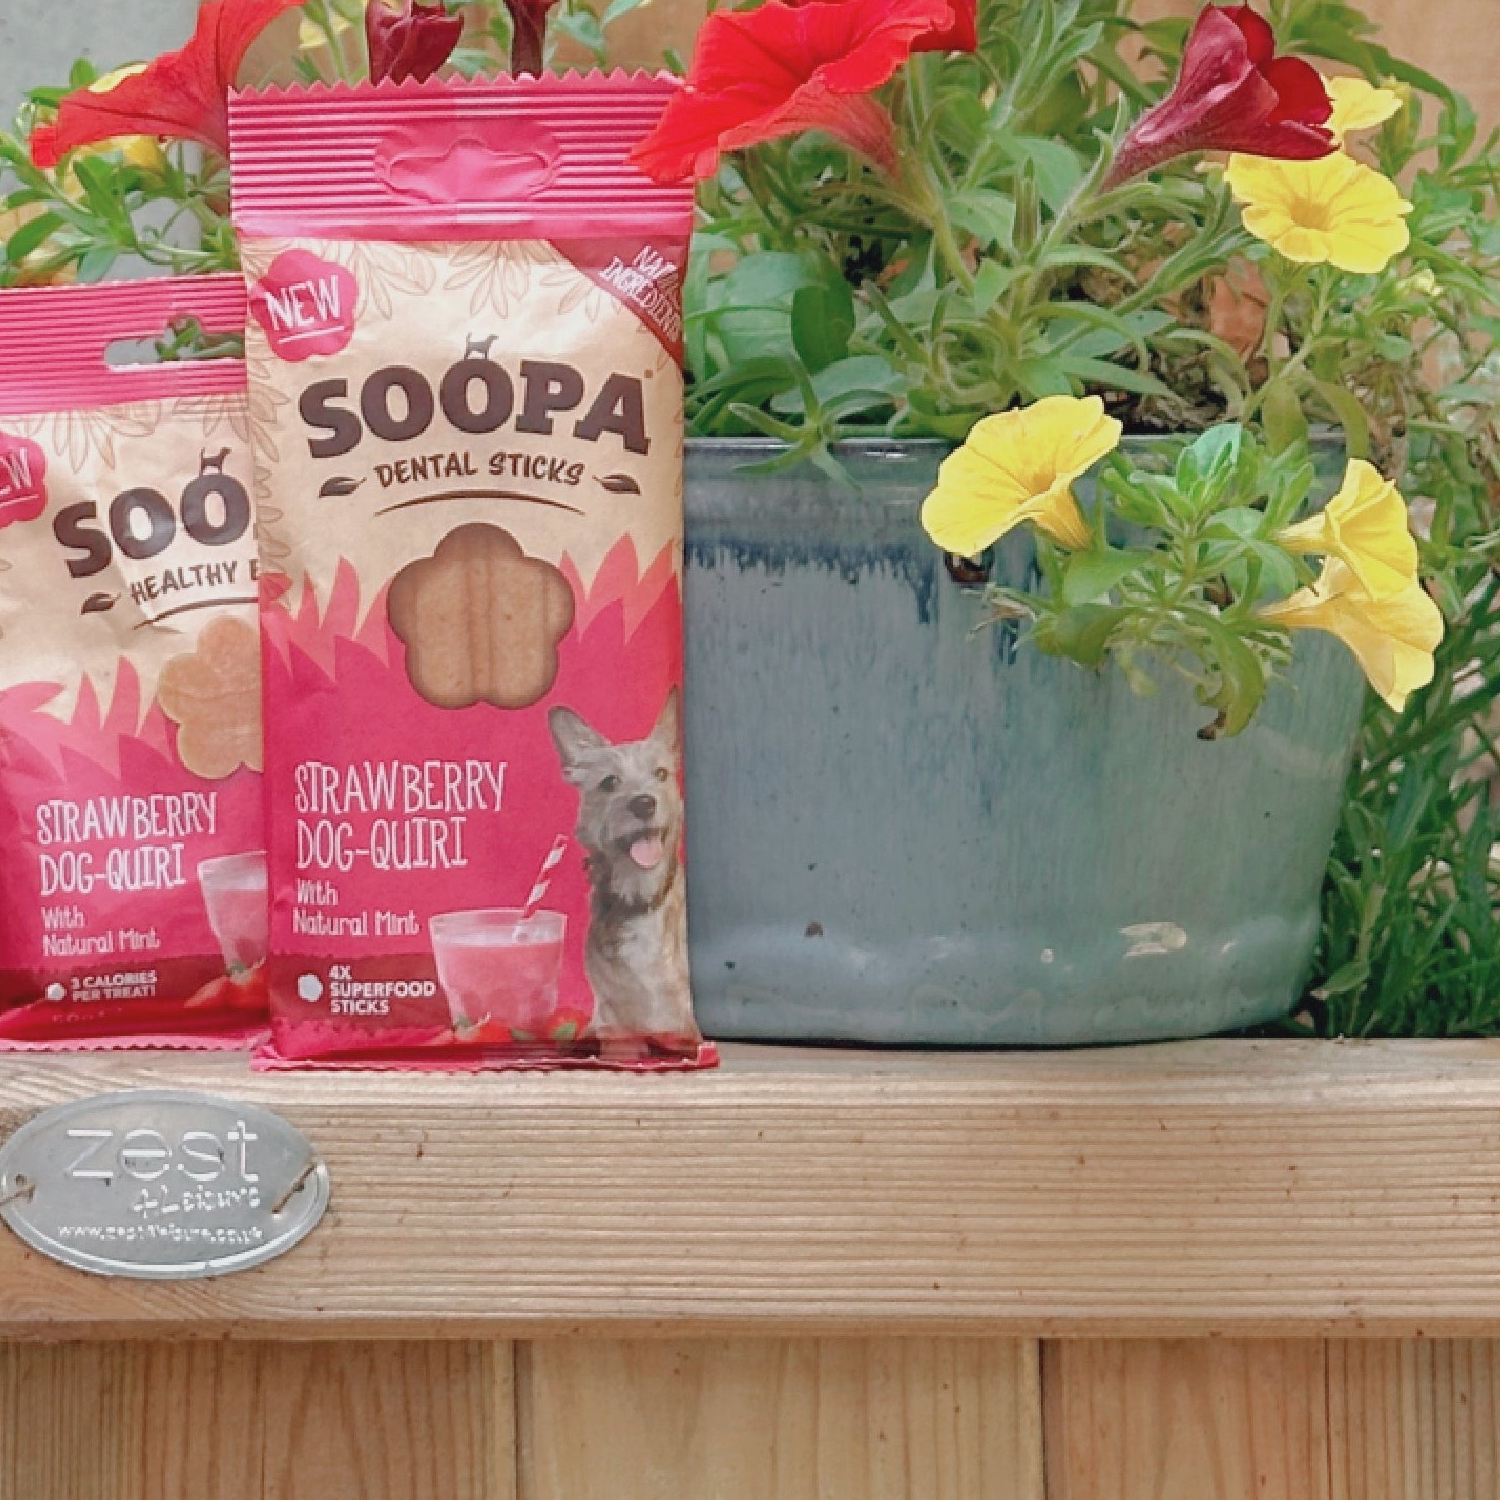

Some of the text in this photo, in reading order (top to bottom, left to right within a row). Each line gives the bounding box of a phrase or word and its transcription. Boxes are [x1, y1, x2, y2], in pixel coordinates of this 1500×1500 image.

[265, 274, 342, 330] NEW
[298, 358, 651, 459] SOOPA
[373, 450, 586, 489] DENTAL STICKS
[52, 473, 258, 579] SOO
[130, 559, 238, 605] HEALTHY
[294, 760, 508, 815] STRAWBERRY
[36, 791, 218, 846] STRAWBERRY
[296, 816, 469, 871] DOG-QUIRI
[40, 843, 187, 896] DOG-QUIRI
[297, 877, 339, 906] With
[41, 904, 86, 930] With
[293, 909, 420, 937] Natural Mint
[42, 926, 160, 957] Natural Mint
[329, 965, 352, 980] 4X
[329, 981, 437, 998] SUPERFOOD
[330, 999, 390, 1015] STICKS
[64, 1119, 260, 1182] zest
